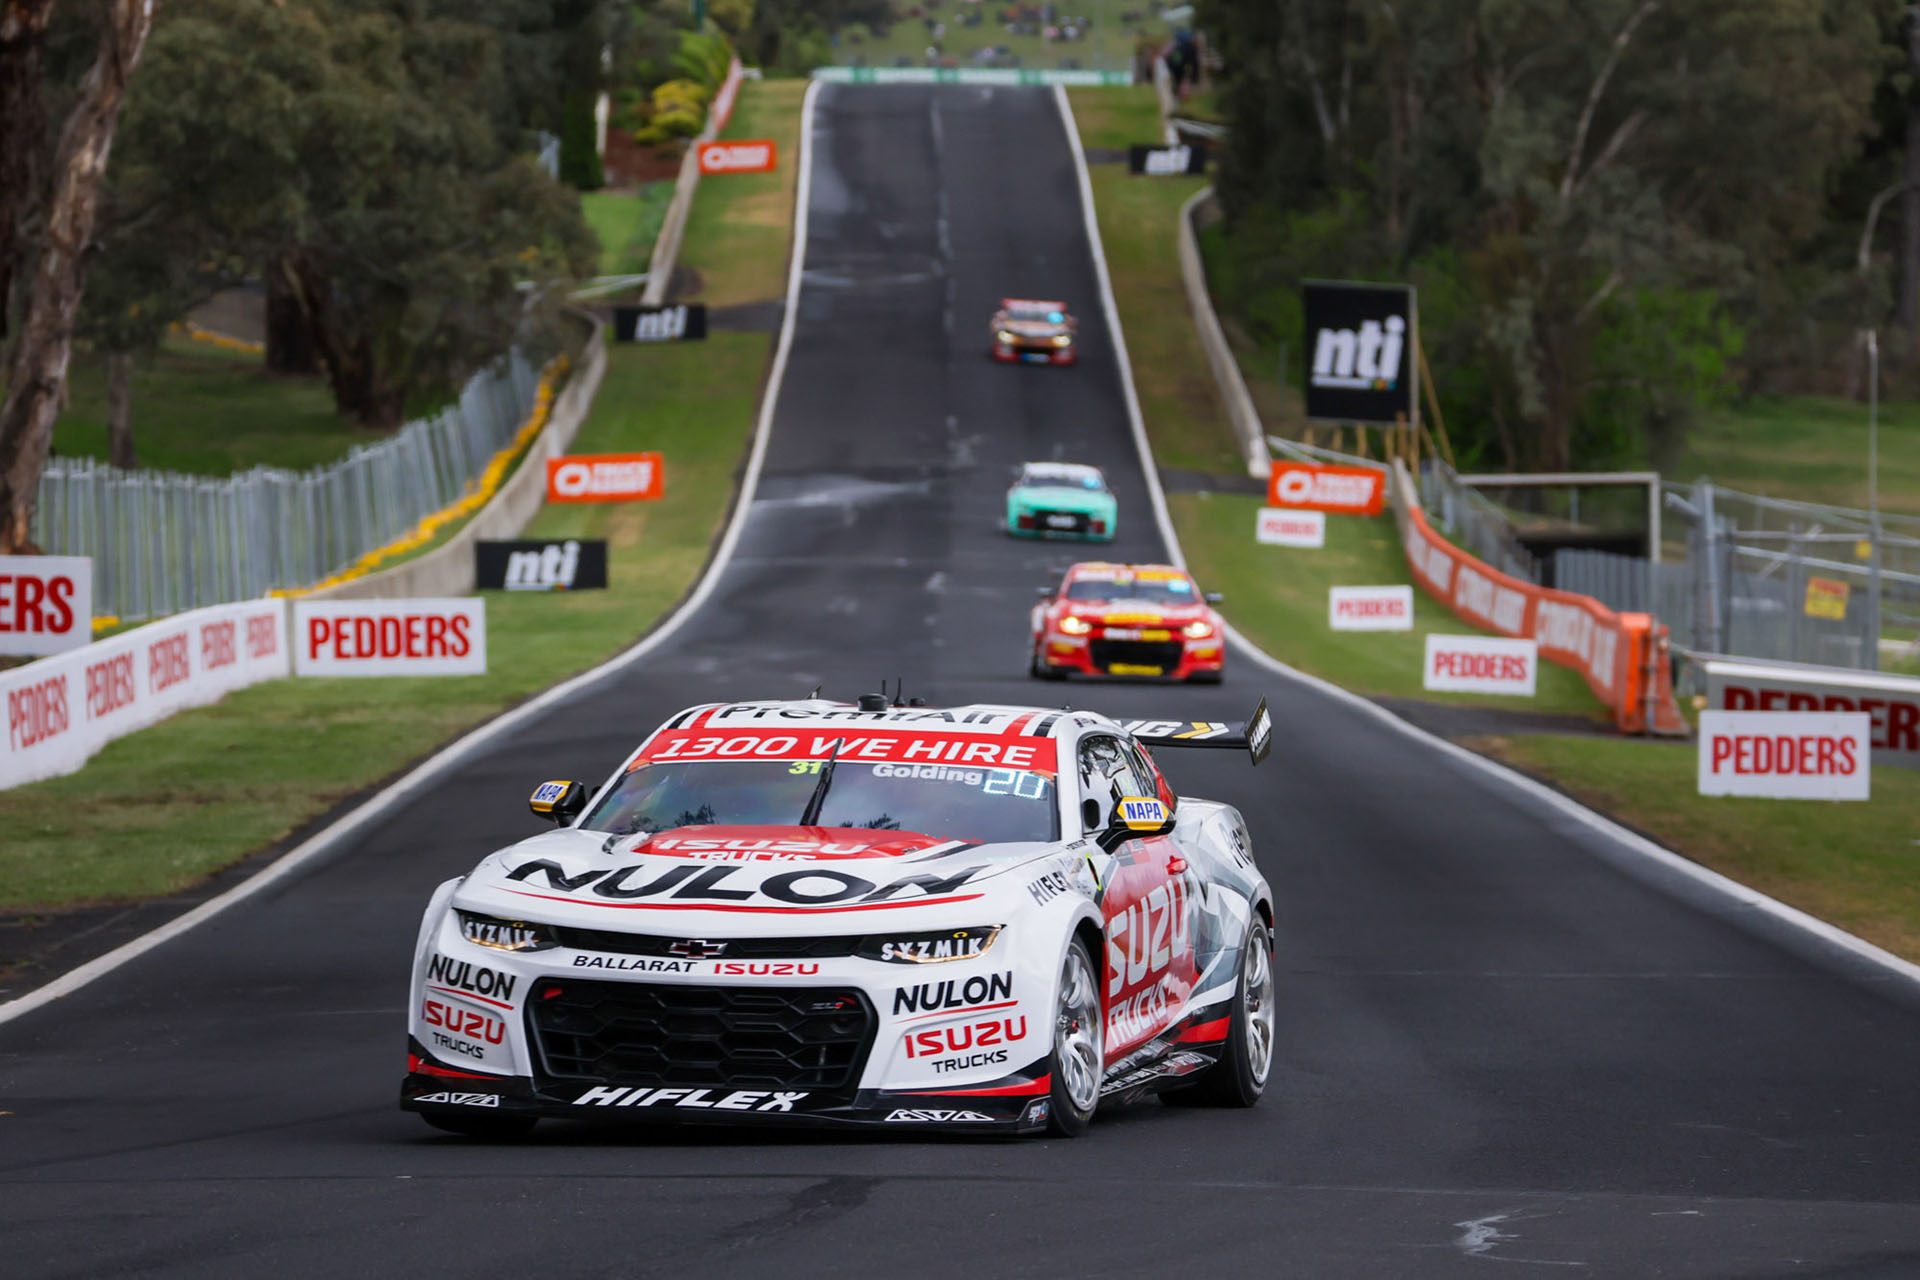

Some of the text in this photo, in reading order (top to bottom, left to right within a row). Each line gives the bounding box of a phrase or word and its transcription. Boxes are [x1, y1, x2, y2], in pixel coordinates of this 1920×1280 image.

[1312, 314, 1405, 379] nti
[505, 540, 580, 585] nti
[309, 614, 472, 661] PEDDERS
[1434, 651, 1528, 681] PEDDERS
[9, 674, 69, 752] PEDDERS
[653, 737, 1037, 766] 1300 WE HIRE
[1712, 735, 1858, 776] PEDDERS
[788, 761, 822, 776] 31
[872, 764, 983, 785] Golding
[983, 769, 1045, 799] 20
[1125, 802, 1163, 820] NAPA
[656, 839, 871, 855] ISUZU
[506, 858, 992, 902] NULON
[881, 937, 983, 960] SYZMIK
[428, 954, 517, 1001] NULON
[573, 955, 820, 976] BALLARAT ISUZU
[893, 971, 1012, 1016] NULON
[422, 998, 506, 1045] ISUZU
[433, 1032, 484, 1059] TRUCKS
[904, 1015, 1026, 1059] ISUZU
[932, 1050, 1008, 1073] TRUCKS
[572, 1086, 809, 1112] HIFLEX
